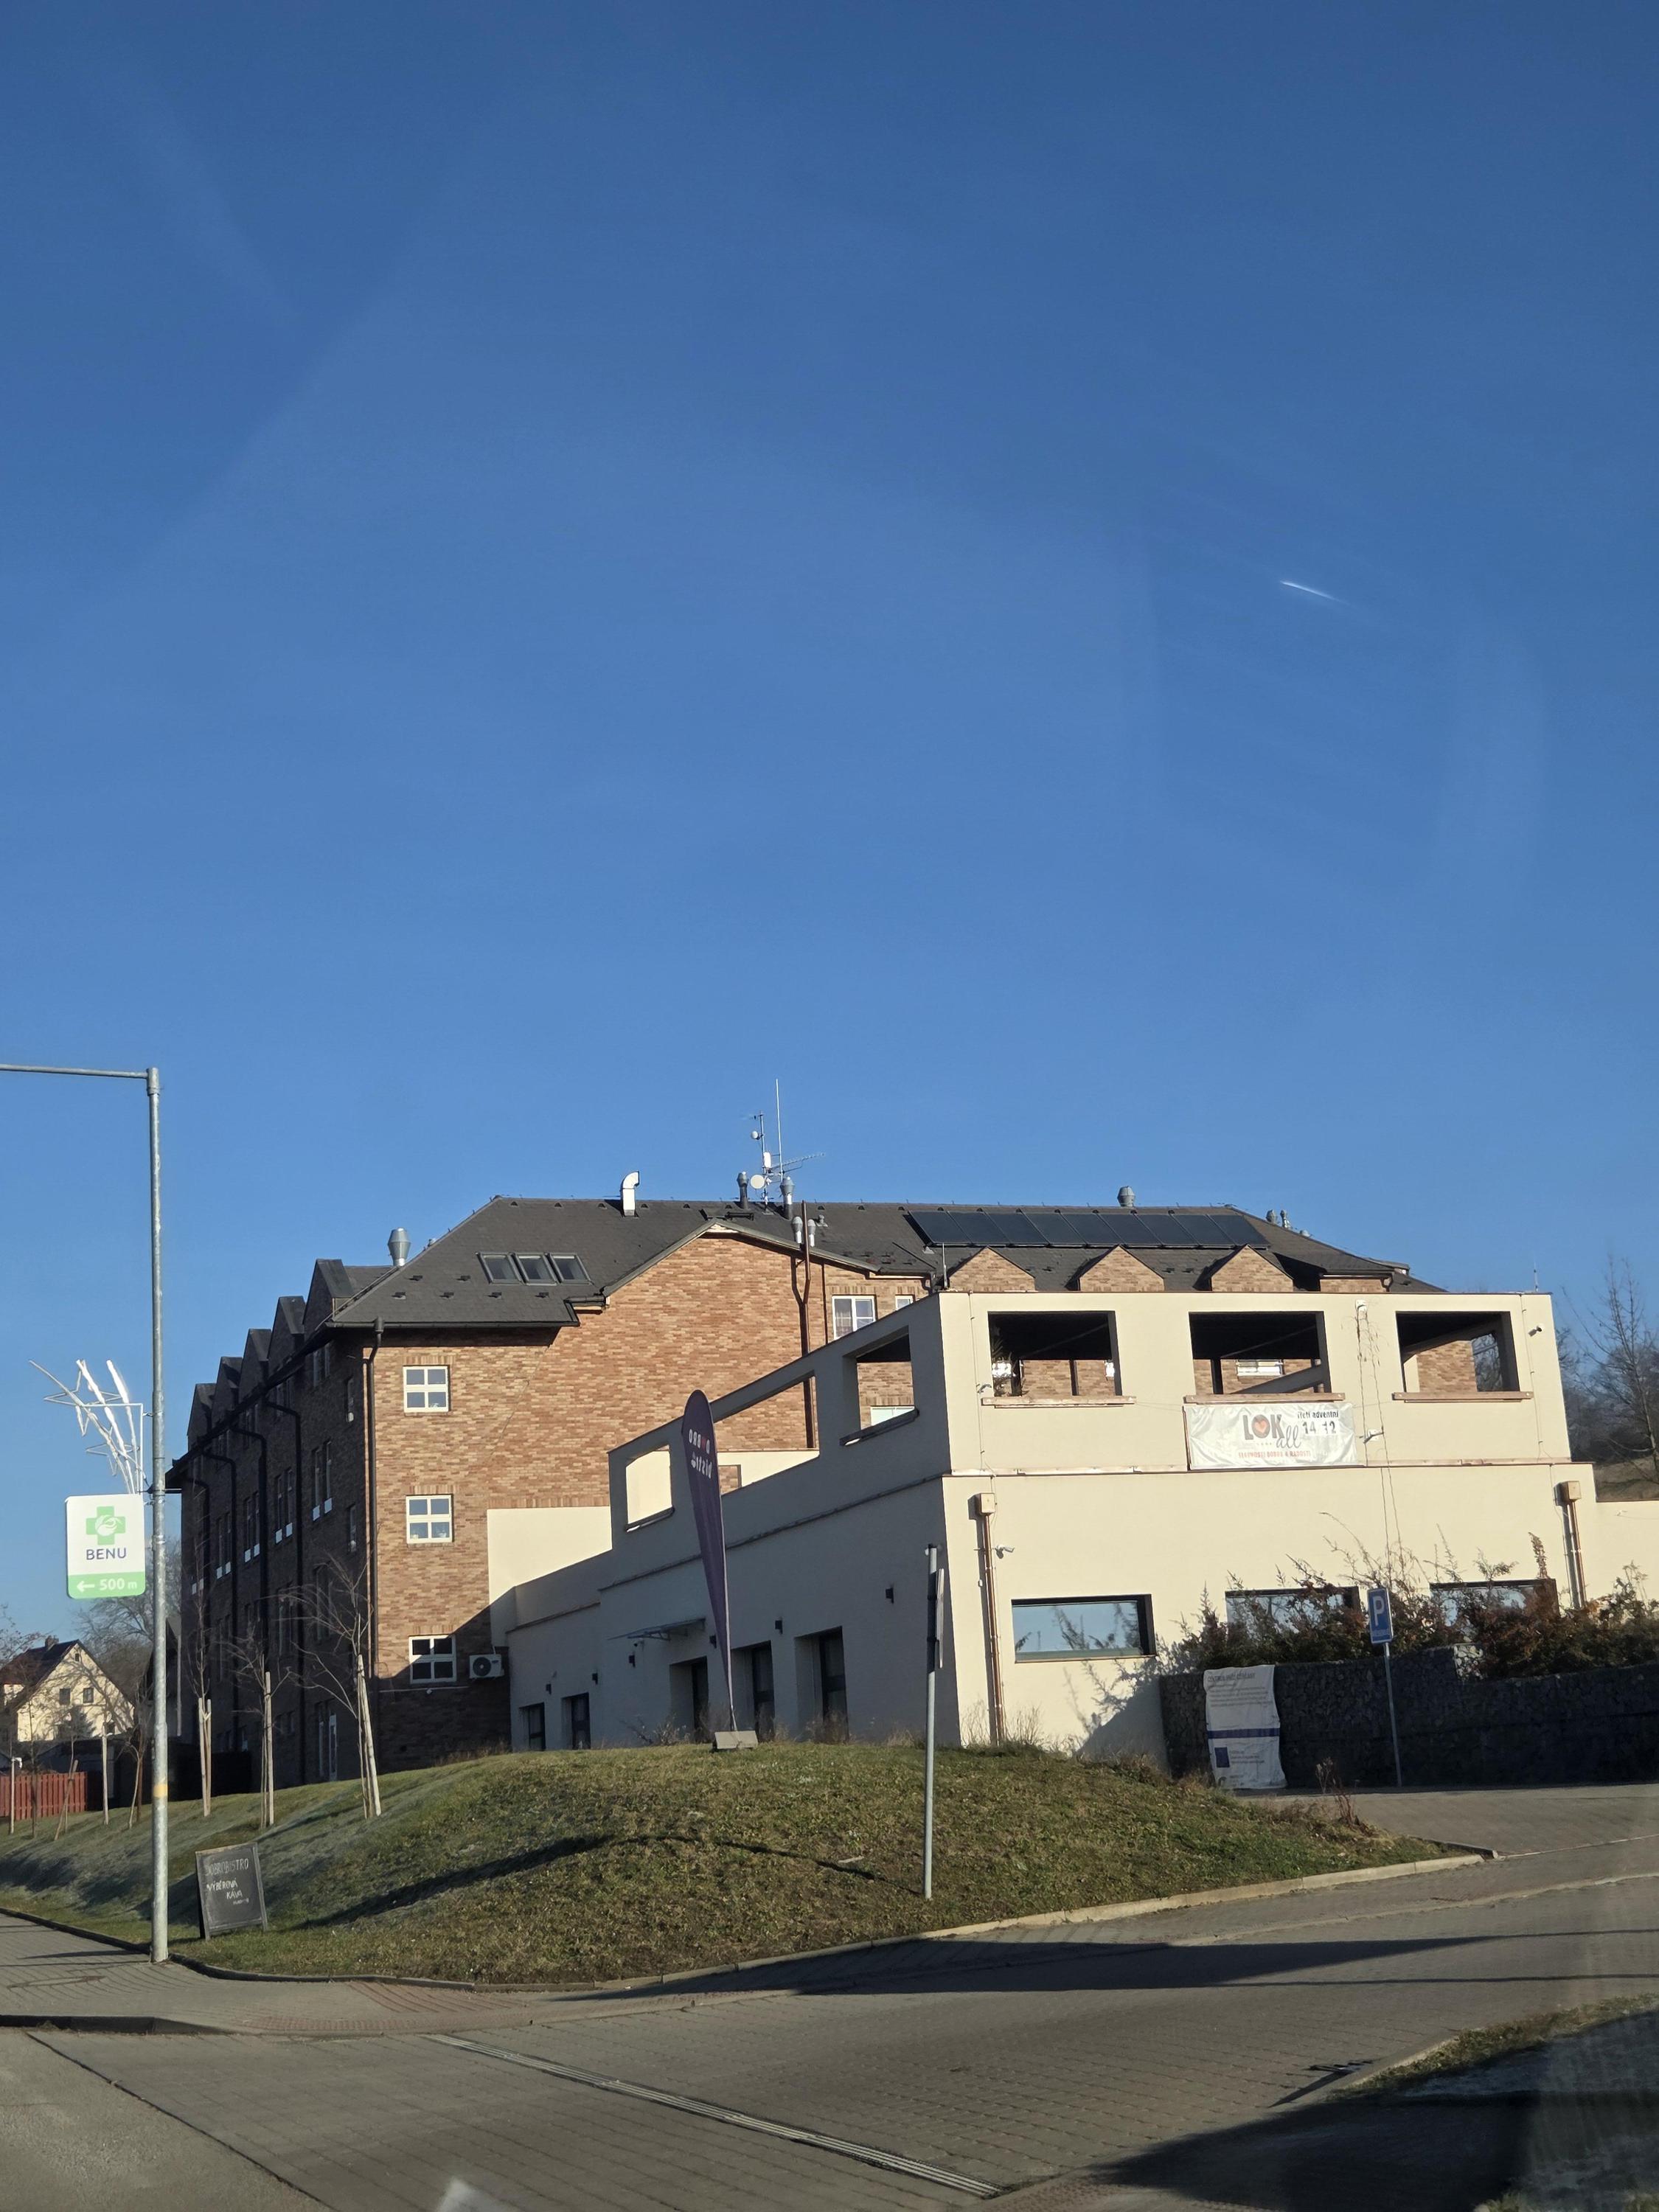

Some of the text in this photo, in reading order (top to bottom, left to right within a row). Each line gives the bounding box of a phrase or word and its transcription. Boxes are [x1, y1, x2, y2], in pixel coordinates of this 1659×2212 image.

[86, 1547, 127, 1561] BENU
[100, 1578, 137, 1591] 500 m
[1373, 1596, 1385, 1627] P
